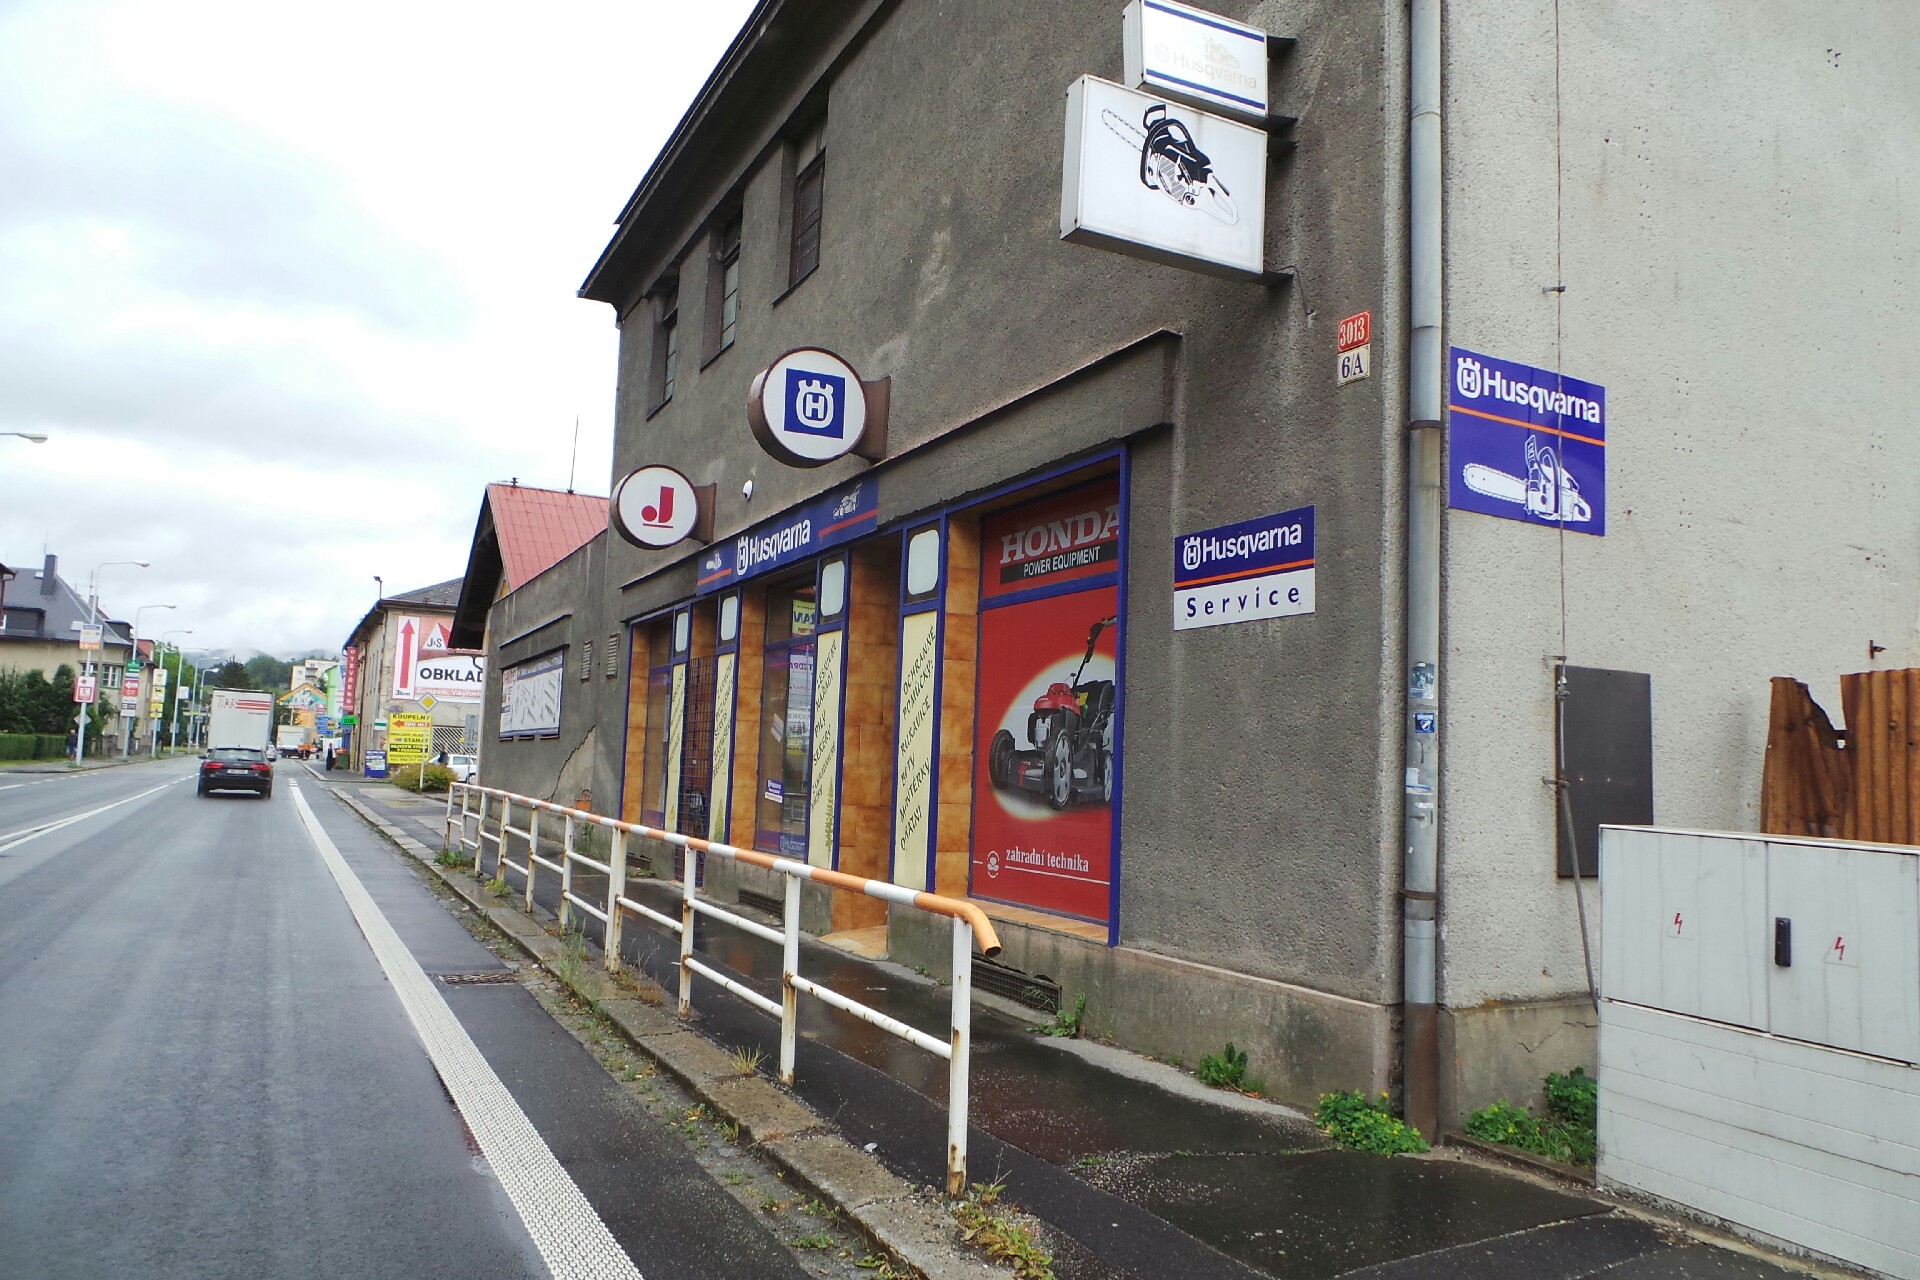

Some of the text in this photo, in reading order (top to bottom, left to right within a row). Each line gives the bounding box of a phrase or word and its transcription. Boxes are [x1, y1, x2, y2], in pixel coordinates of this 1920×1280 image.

[1174, 51, 1257, 89] Husqvarna
[1340, 317, 1364, 346] 3013
[1483, 368, 1600, 424] Husqvarna
[750, 519, 811, 566] Husqvarna
[1000, 504, 1119, 564] HONDA
[1202, 523, 1302, 563] Husqvarna
[1024, 546, 1101, 577] POWER EQUIPMENT
[1187, 586, 1299, 618] Service
[900, 695, 931, 757] RUKAVICE
[1006, 846, 1089, 873] zahradní technika
